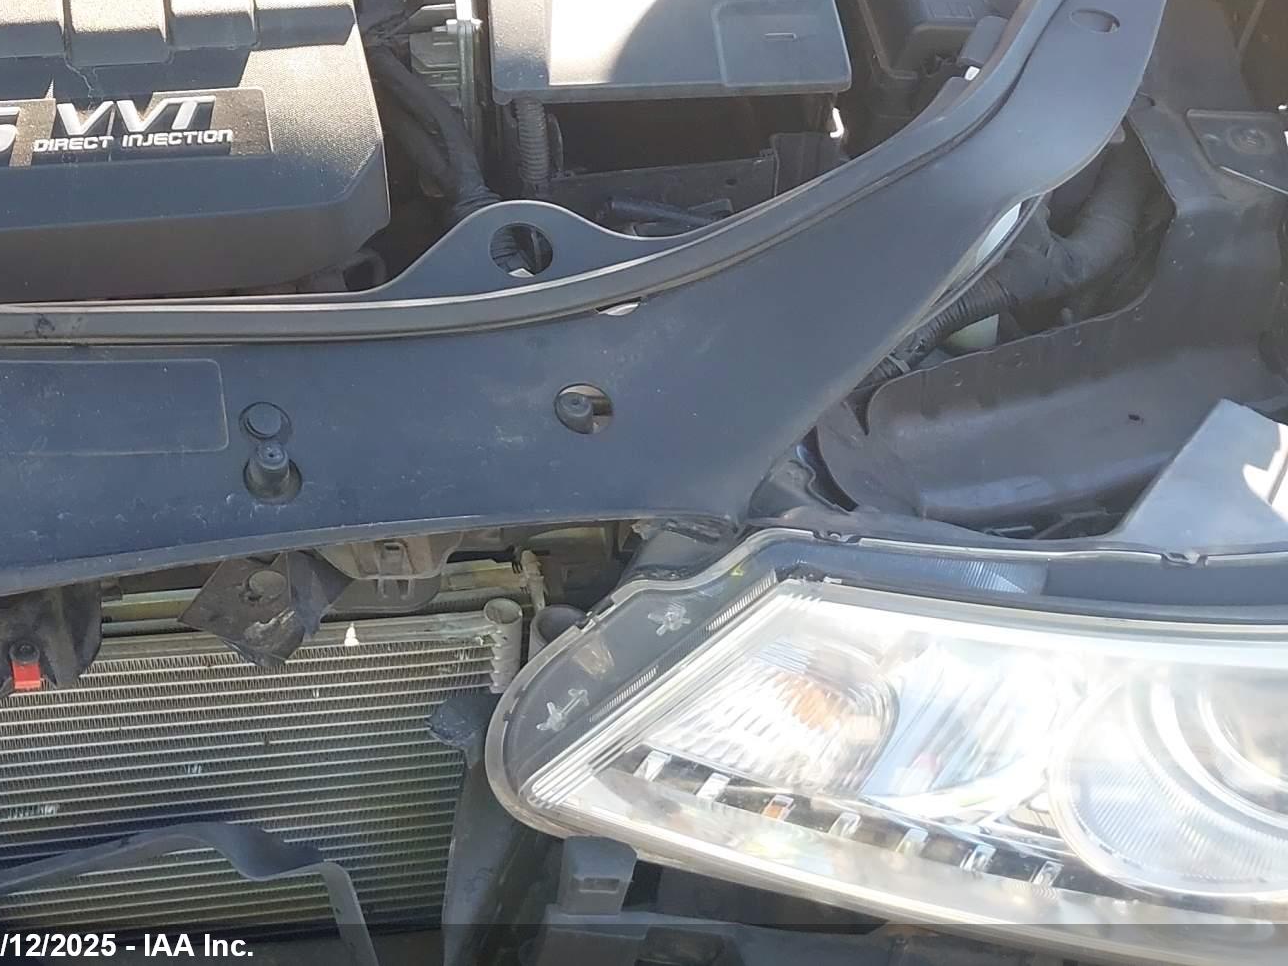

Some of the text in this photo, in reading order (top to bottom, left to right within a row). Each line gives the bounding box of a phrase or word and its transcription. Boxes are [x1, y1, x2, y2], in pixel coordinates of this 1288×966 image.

[56, 95, 217, 136] VVT
[33, 129, 233, 152] DIRECT INJECTION
